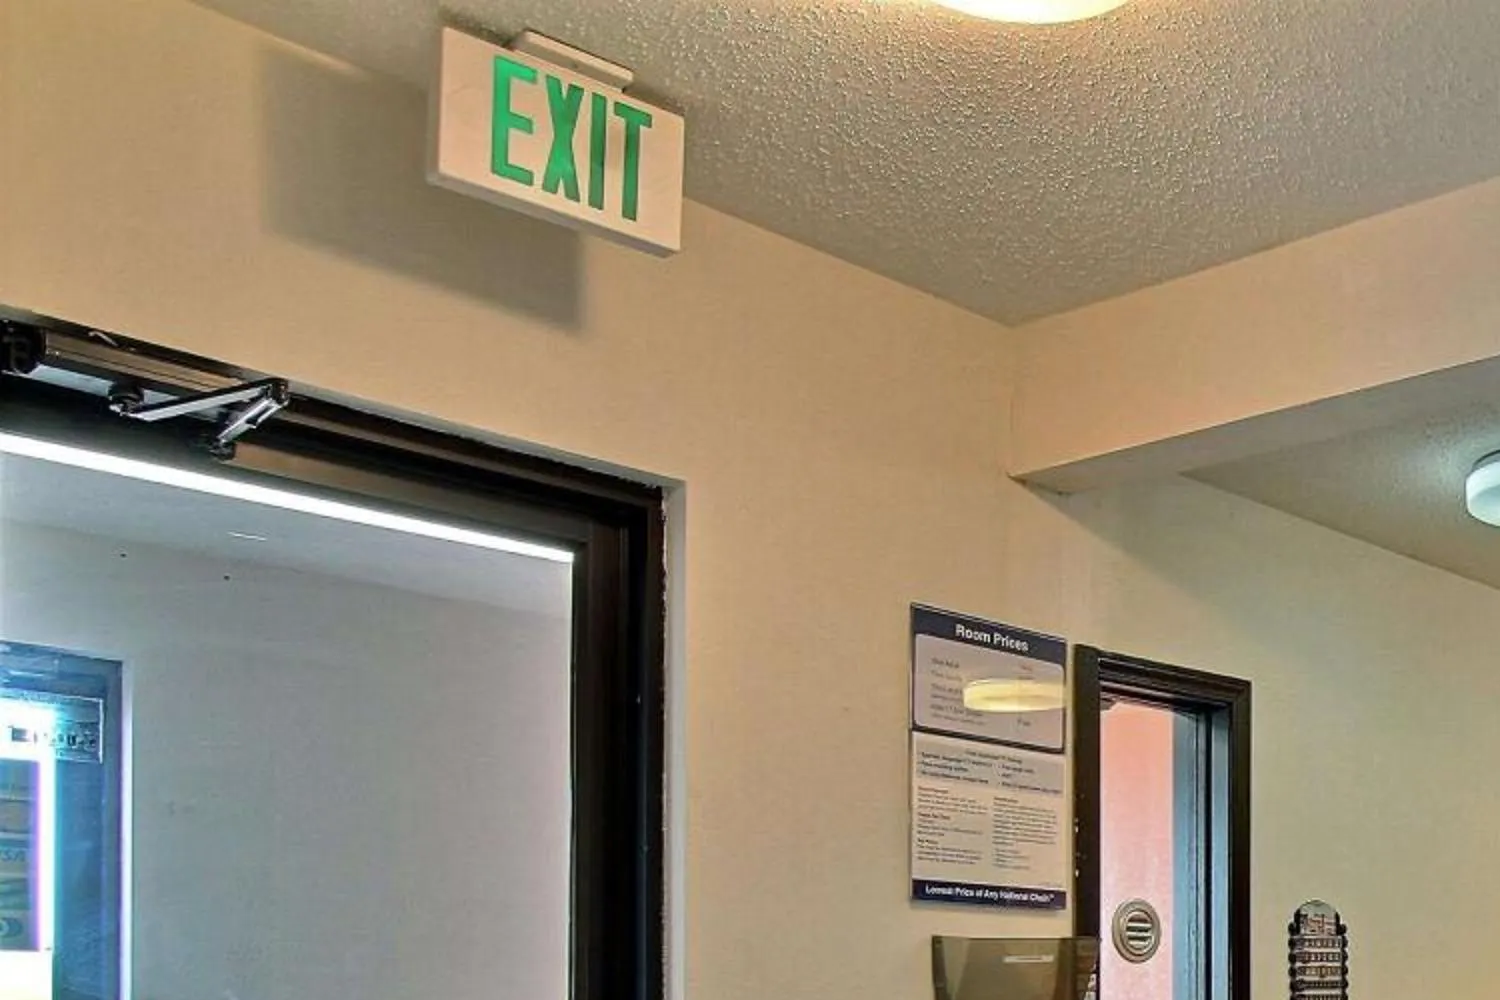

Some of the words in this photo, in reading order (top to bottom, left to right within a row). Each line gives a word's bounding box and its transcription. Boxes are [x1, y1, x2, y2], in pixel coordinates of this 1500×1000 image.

[490, 54, 653, 222] EXIT
[955, 624, 991, 643] Room
[993, 633, 1029, 651] Prices
